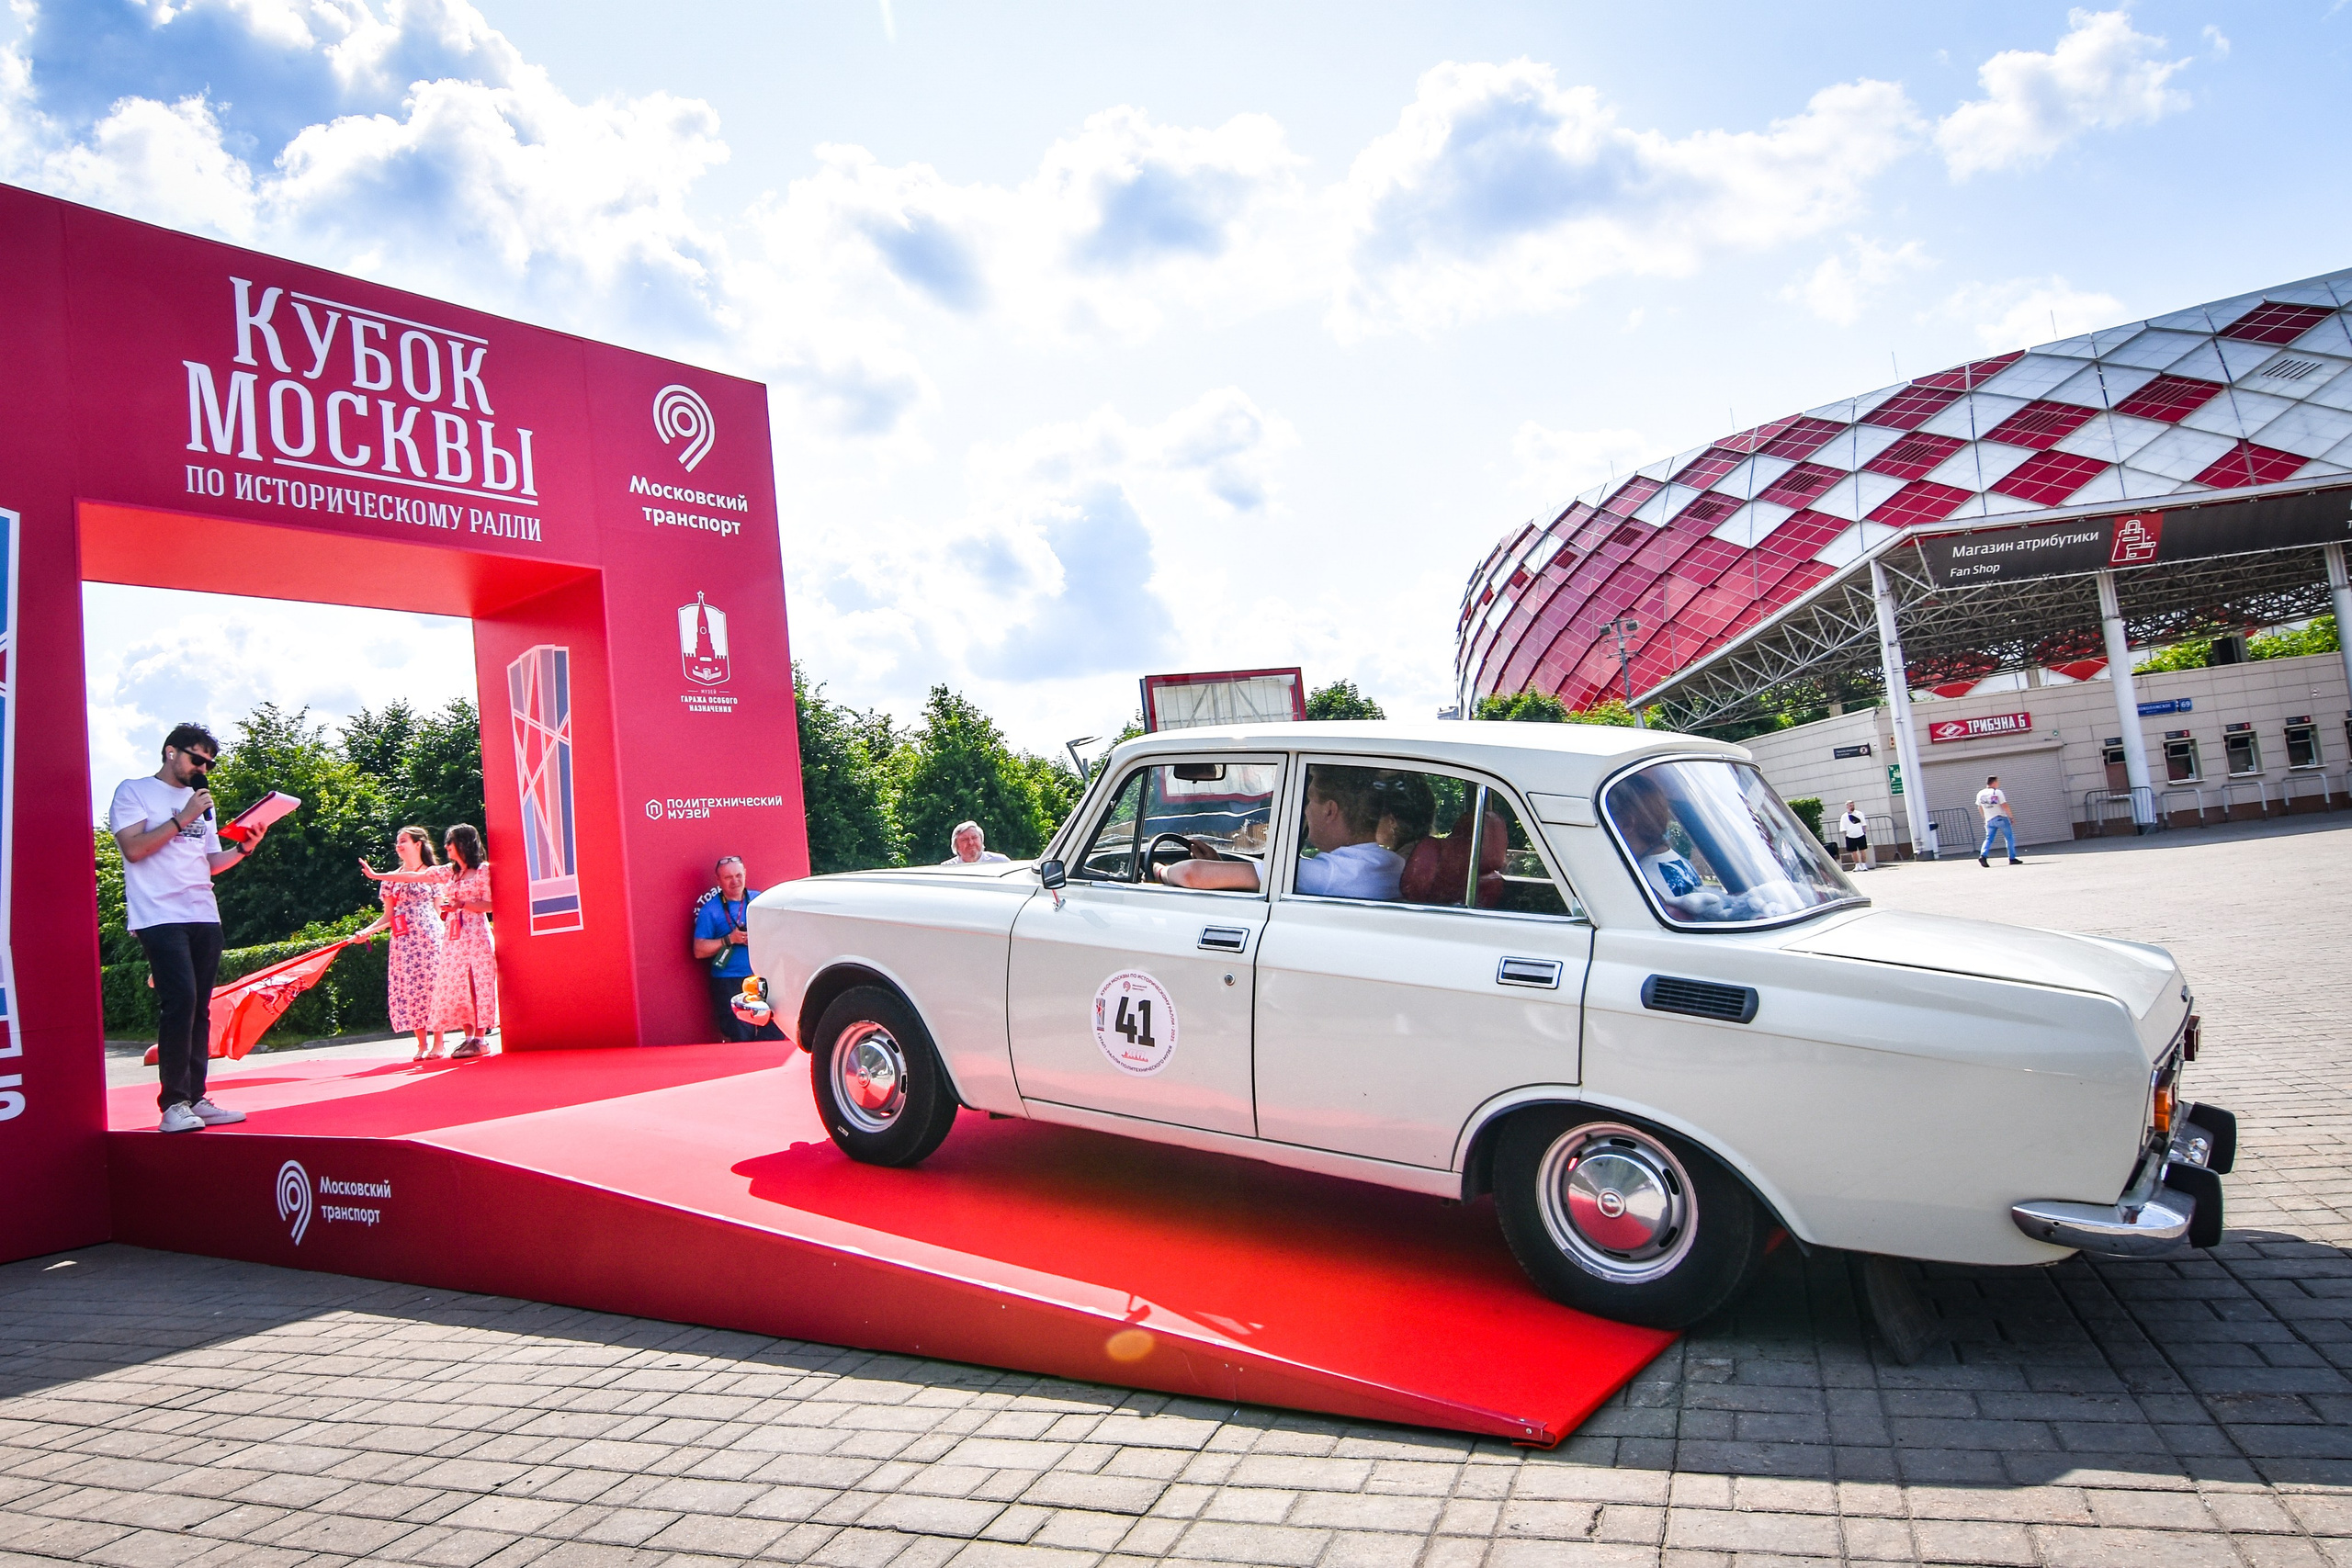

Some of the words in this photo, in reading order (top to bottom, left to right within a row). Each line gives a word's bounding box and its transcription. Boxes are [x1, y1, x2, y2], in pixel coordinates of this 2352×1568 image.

[230, 276, 494, 415] КУБОК
[183, 359, 538, 497] МОСКВЫ
[186, 465, 224, 497] ПО
[234, 472, 463, 530] ИСТОРИЧЕСКОМУ
[469, 509, 542, 542] РАЛЛИ
[628, 475, 748, 513] Московский
[642, 505, 741, 536] транспорт
[1952, 542, 2013, 558] Магазин
[2016, 531, 2098, 551] атрибутики
[1950, 567, 1970, 578] Fan
[1973, 564, 2000, 576] Shop
[681, 695, 707, 704] ГАРАЖА
[708, 696, 738, 705] ОСОБОГО
[689, 705, 731, 713] НАЗНАЧЕНИЯ
[1966, 716, 2016, 734] ТРИБУНА
[1115, 997, 1155, 1047] 41
[320, 1176, 391, 1198] Московский
[321, 1204, 380, 1226] транспорт
